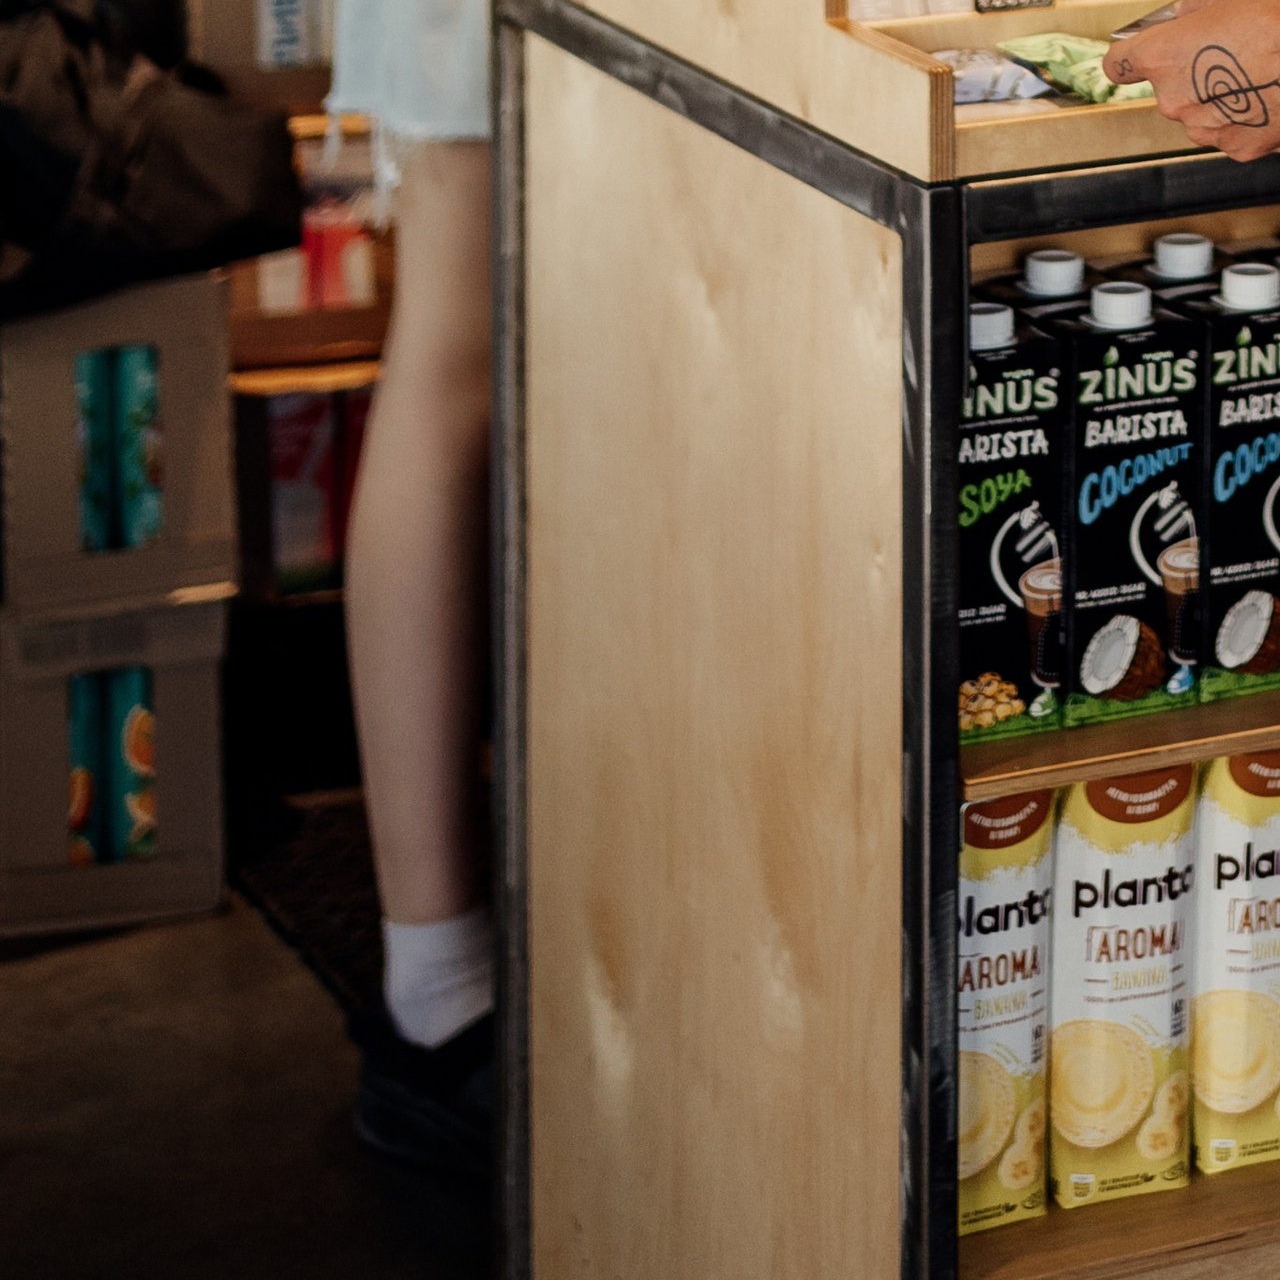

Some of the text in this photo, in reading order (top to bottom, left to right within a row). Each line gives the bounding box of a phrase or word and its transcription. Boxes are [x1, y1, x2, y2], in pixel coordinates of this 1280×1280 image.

[1078, 358, 1198, 405] ZINUS
[958, 429, 1050, 464] ARISTA
[1084, 410, 1188, 448] BARISTA
[958, 468, 1033, 527] SOYA
[1078, 442, 1194, 526] COCONUT
[1095, 925, 1180, 963] AROMA
[958, 945, 1042, 993] AROMA
